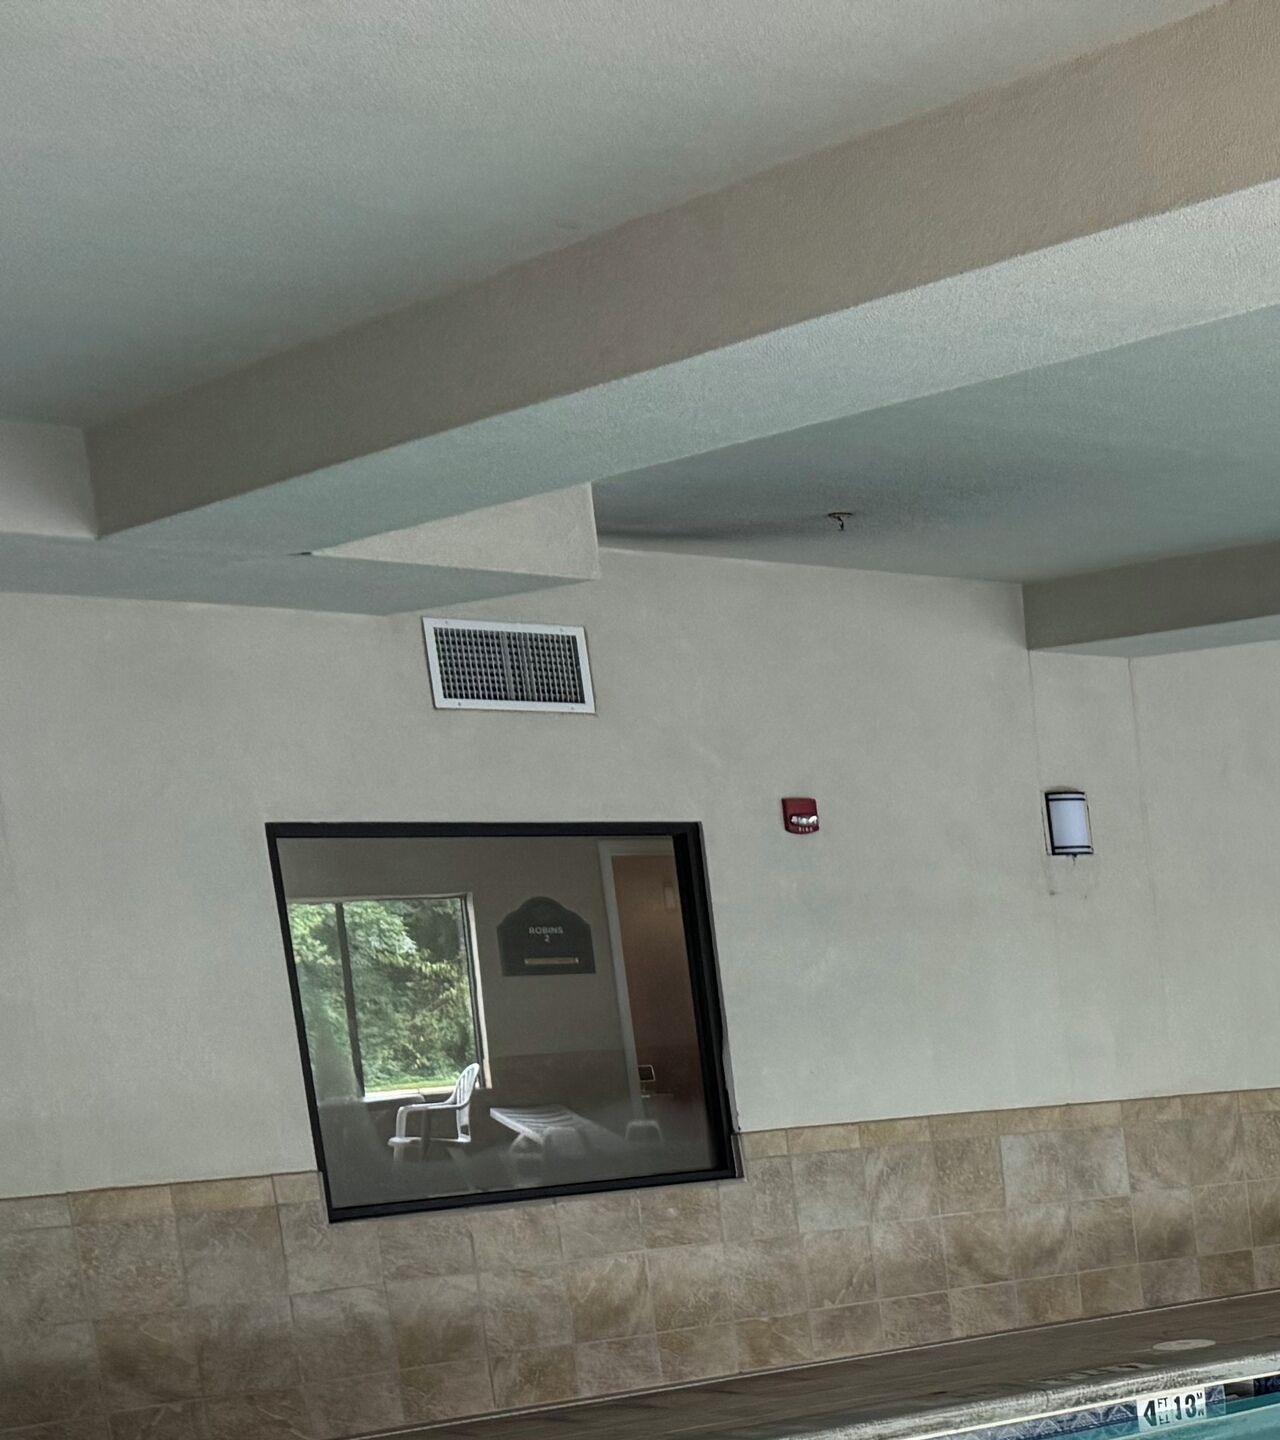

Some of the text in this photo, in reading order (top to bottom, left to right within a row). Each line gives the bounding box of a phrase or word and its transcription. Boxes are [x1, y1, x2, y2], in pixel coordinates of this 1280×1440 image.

[528, 926, 564, 935] ROBINS
[1143, 1400, 1157, 1426] 4
[1157, 1397, 1168, 1409] FT
